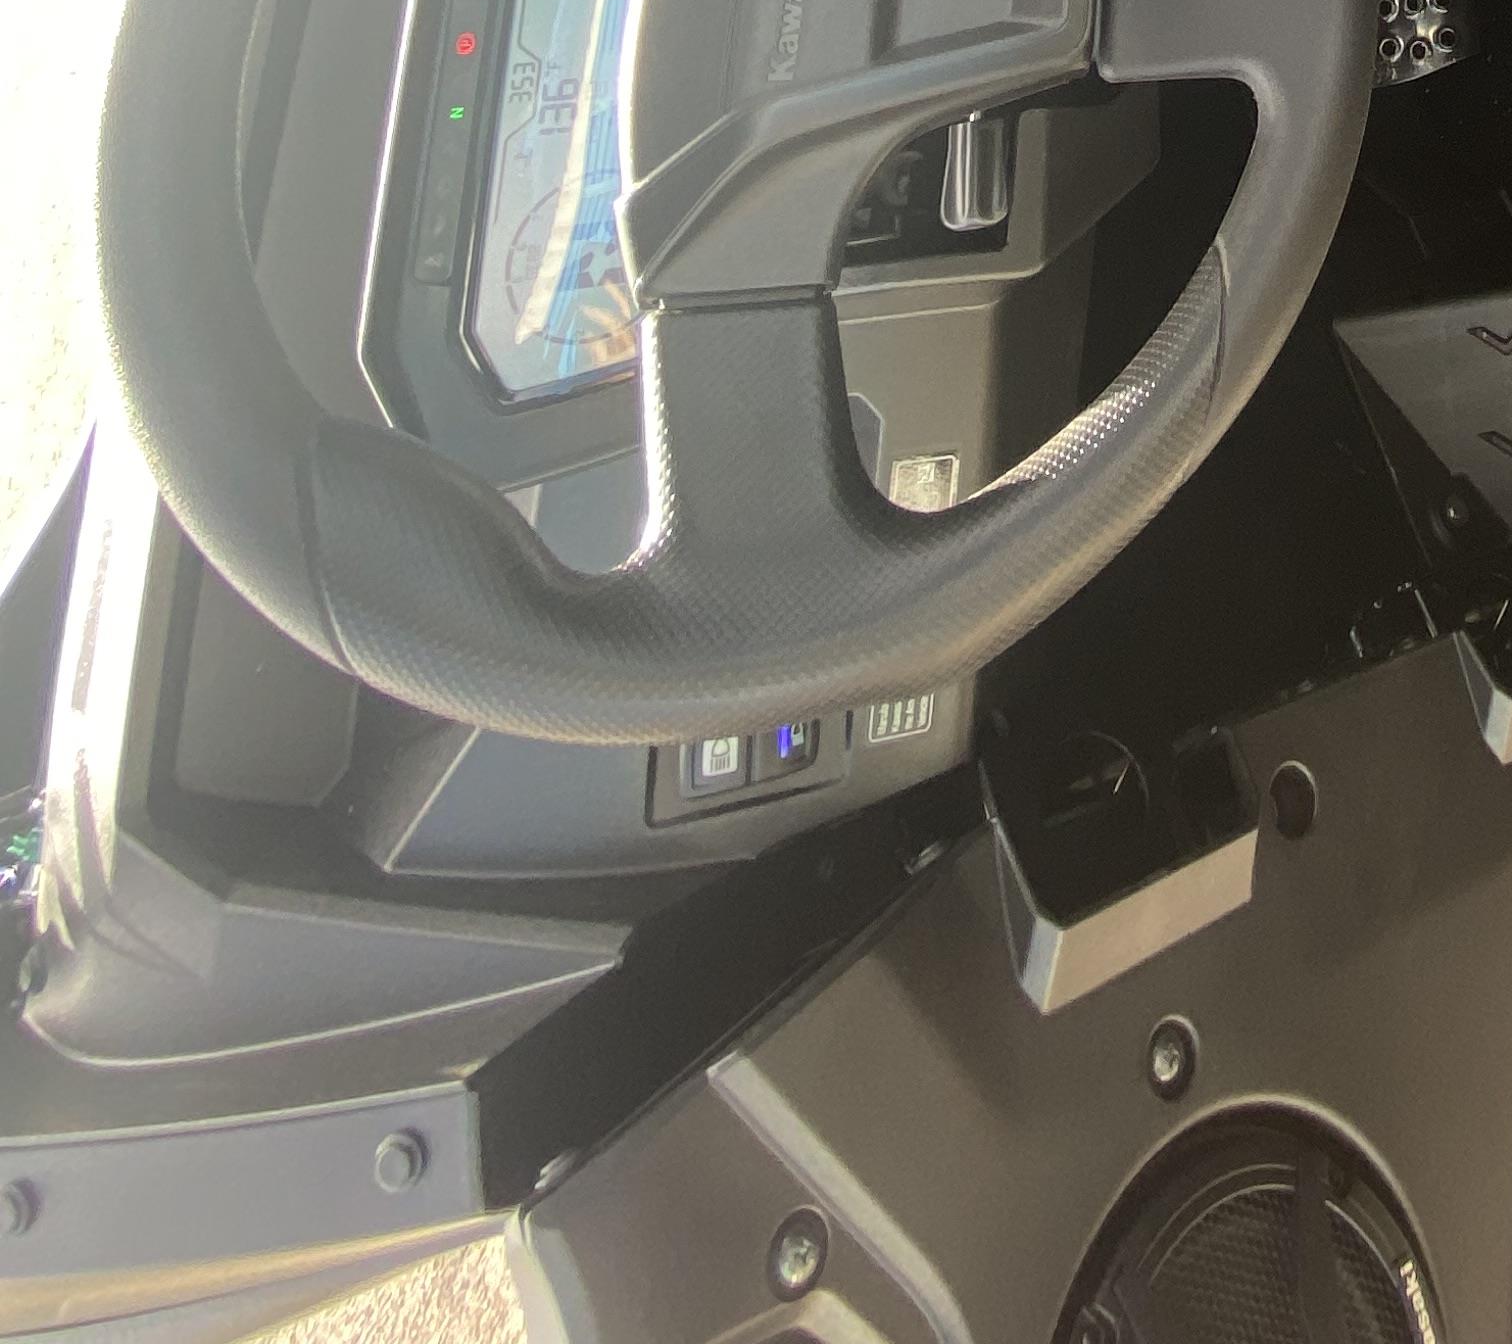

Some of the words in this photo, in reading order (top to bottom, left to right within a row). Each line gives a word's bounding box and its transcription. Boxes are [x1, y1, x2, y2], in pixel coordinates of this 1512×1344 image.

[507, 61, 536, 104] 353
[537, 77, 579, 136] 136
[448, 105, 465, 120] N
[1400, 1257, 1437, 1344] asaki
